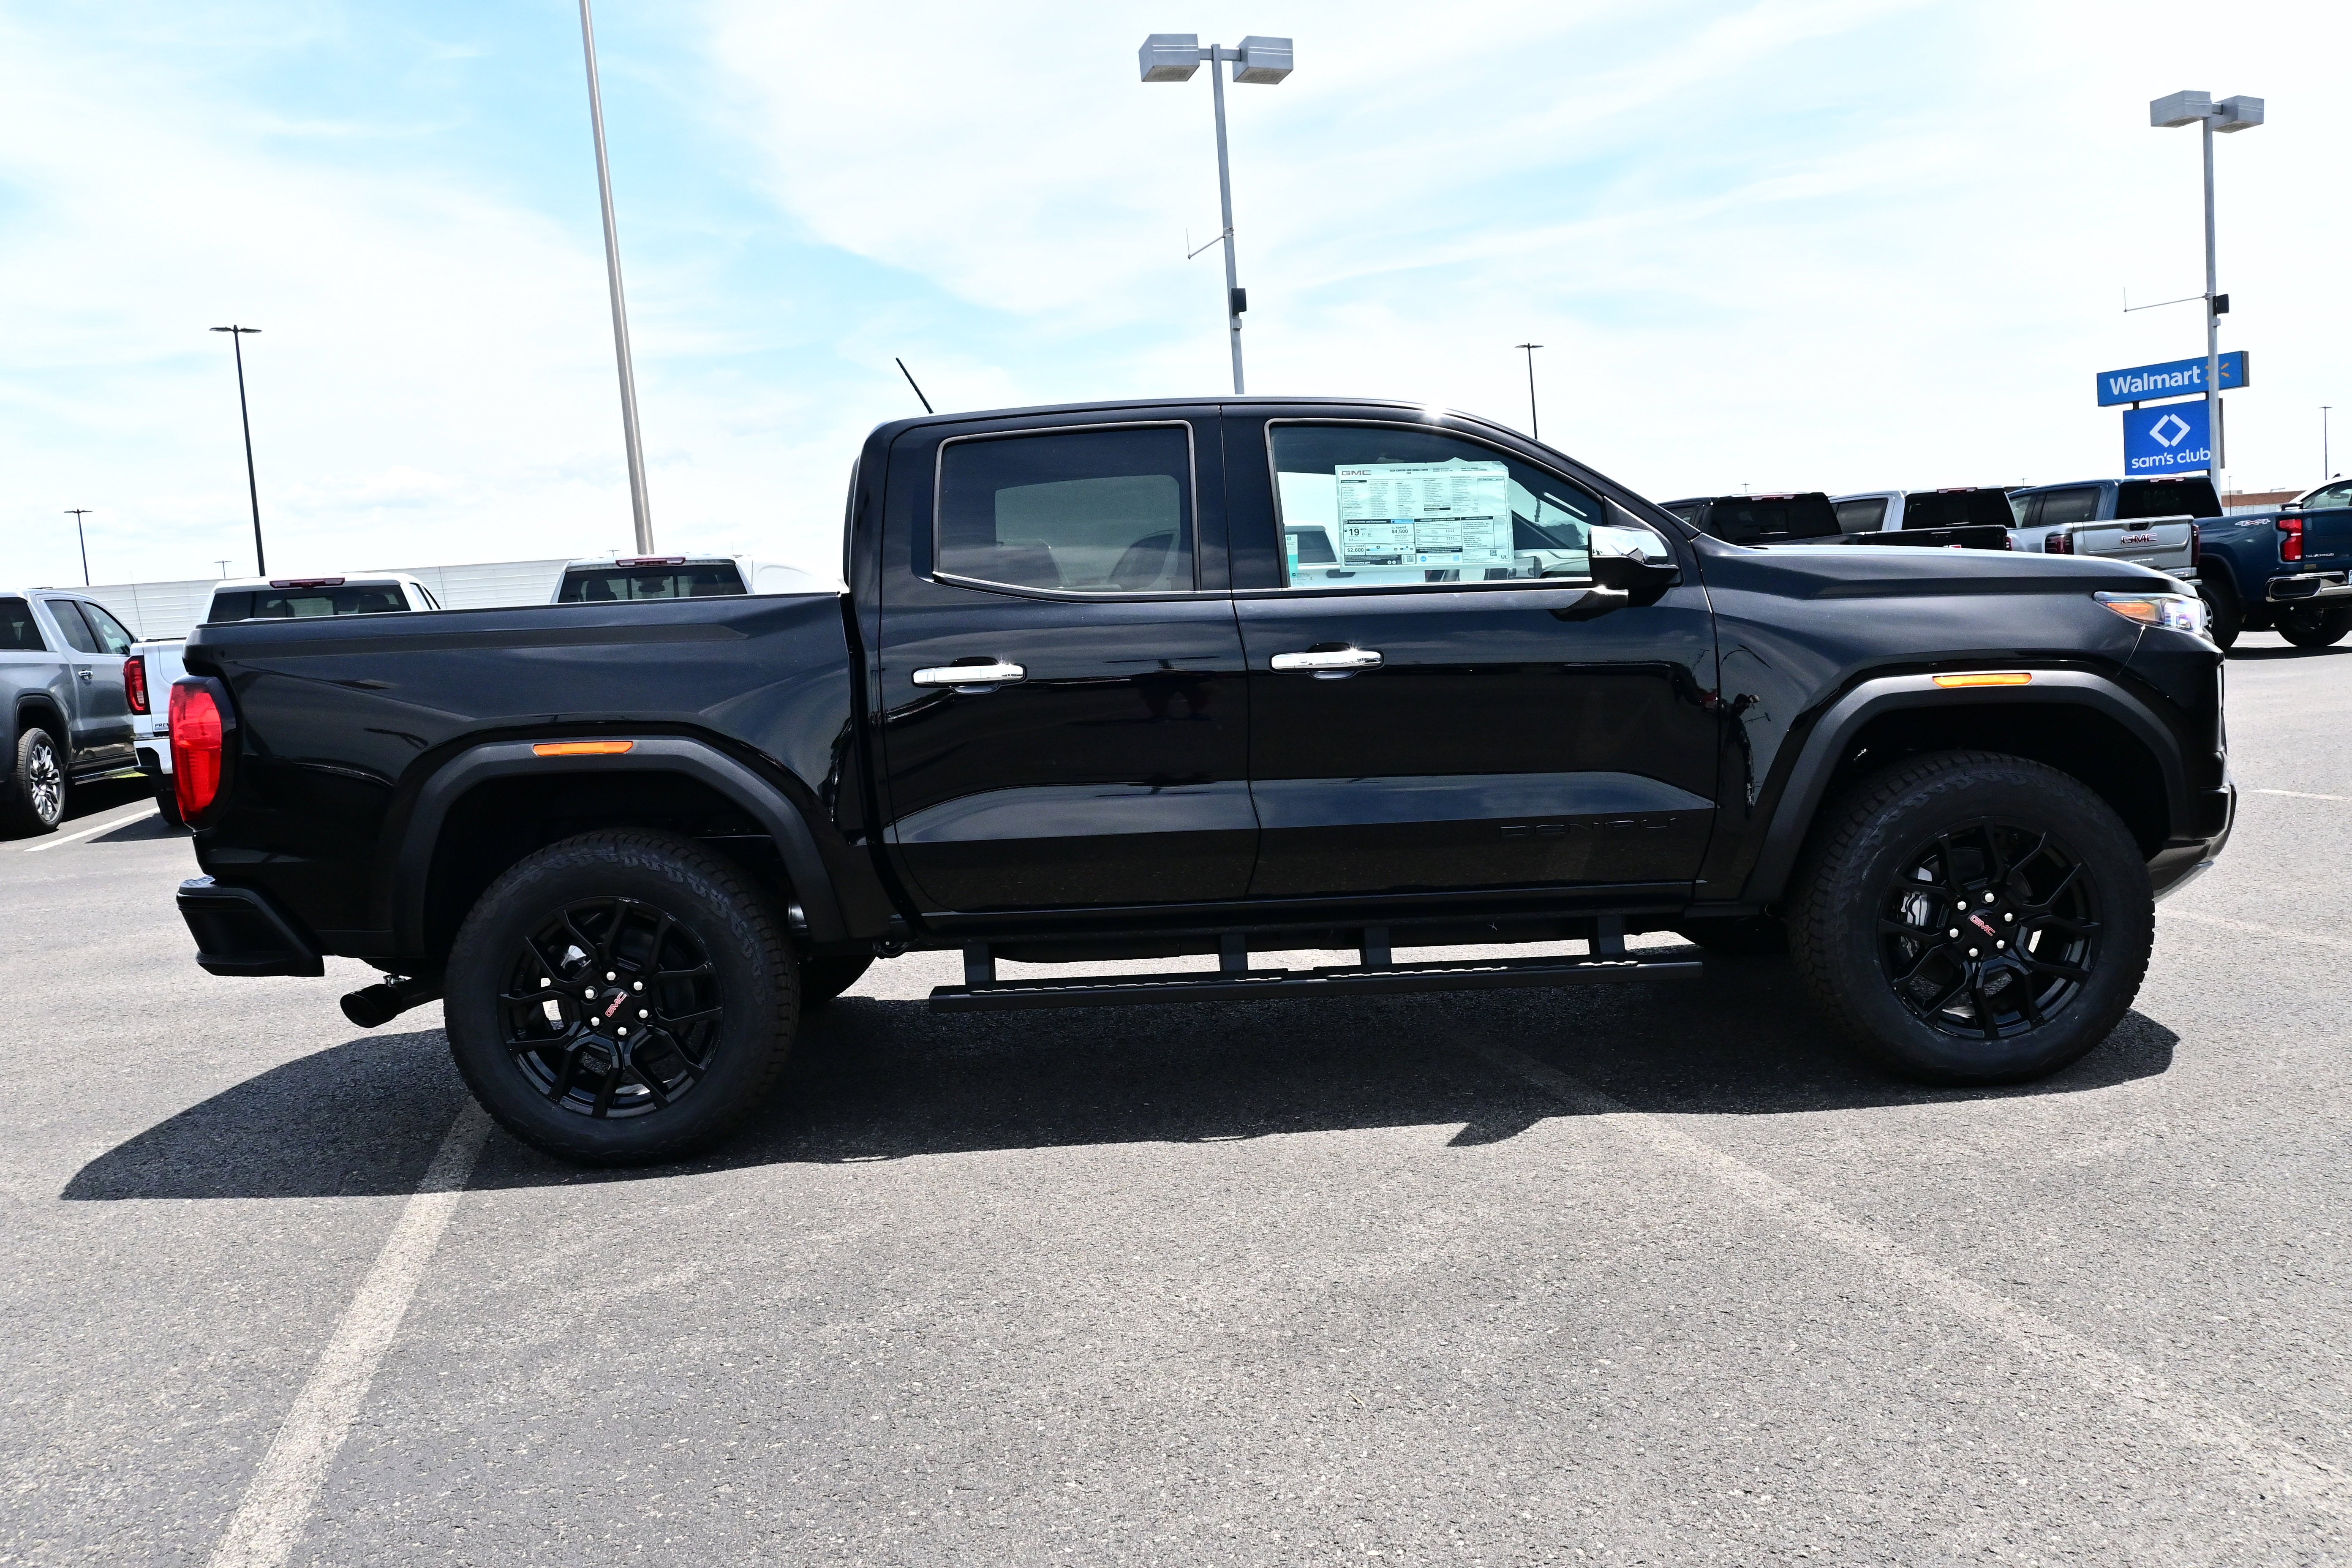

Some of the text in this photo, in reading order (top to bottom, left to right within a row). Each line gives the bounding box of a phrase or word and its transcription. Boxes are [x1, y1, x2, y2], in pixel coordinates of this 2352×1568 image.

[2110, 366, 2200, 395] Walmart
[2132, 447, 2210, 468] sam's club
[2121, 533, 2157, 545] GMC
[1970, 915, 1995, 936] GMC
[605, 991, 627, 1017] GMC
